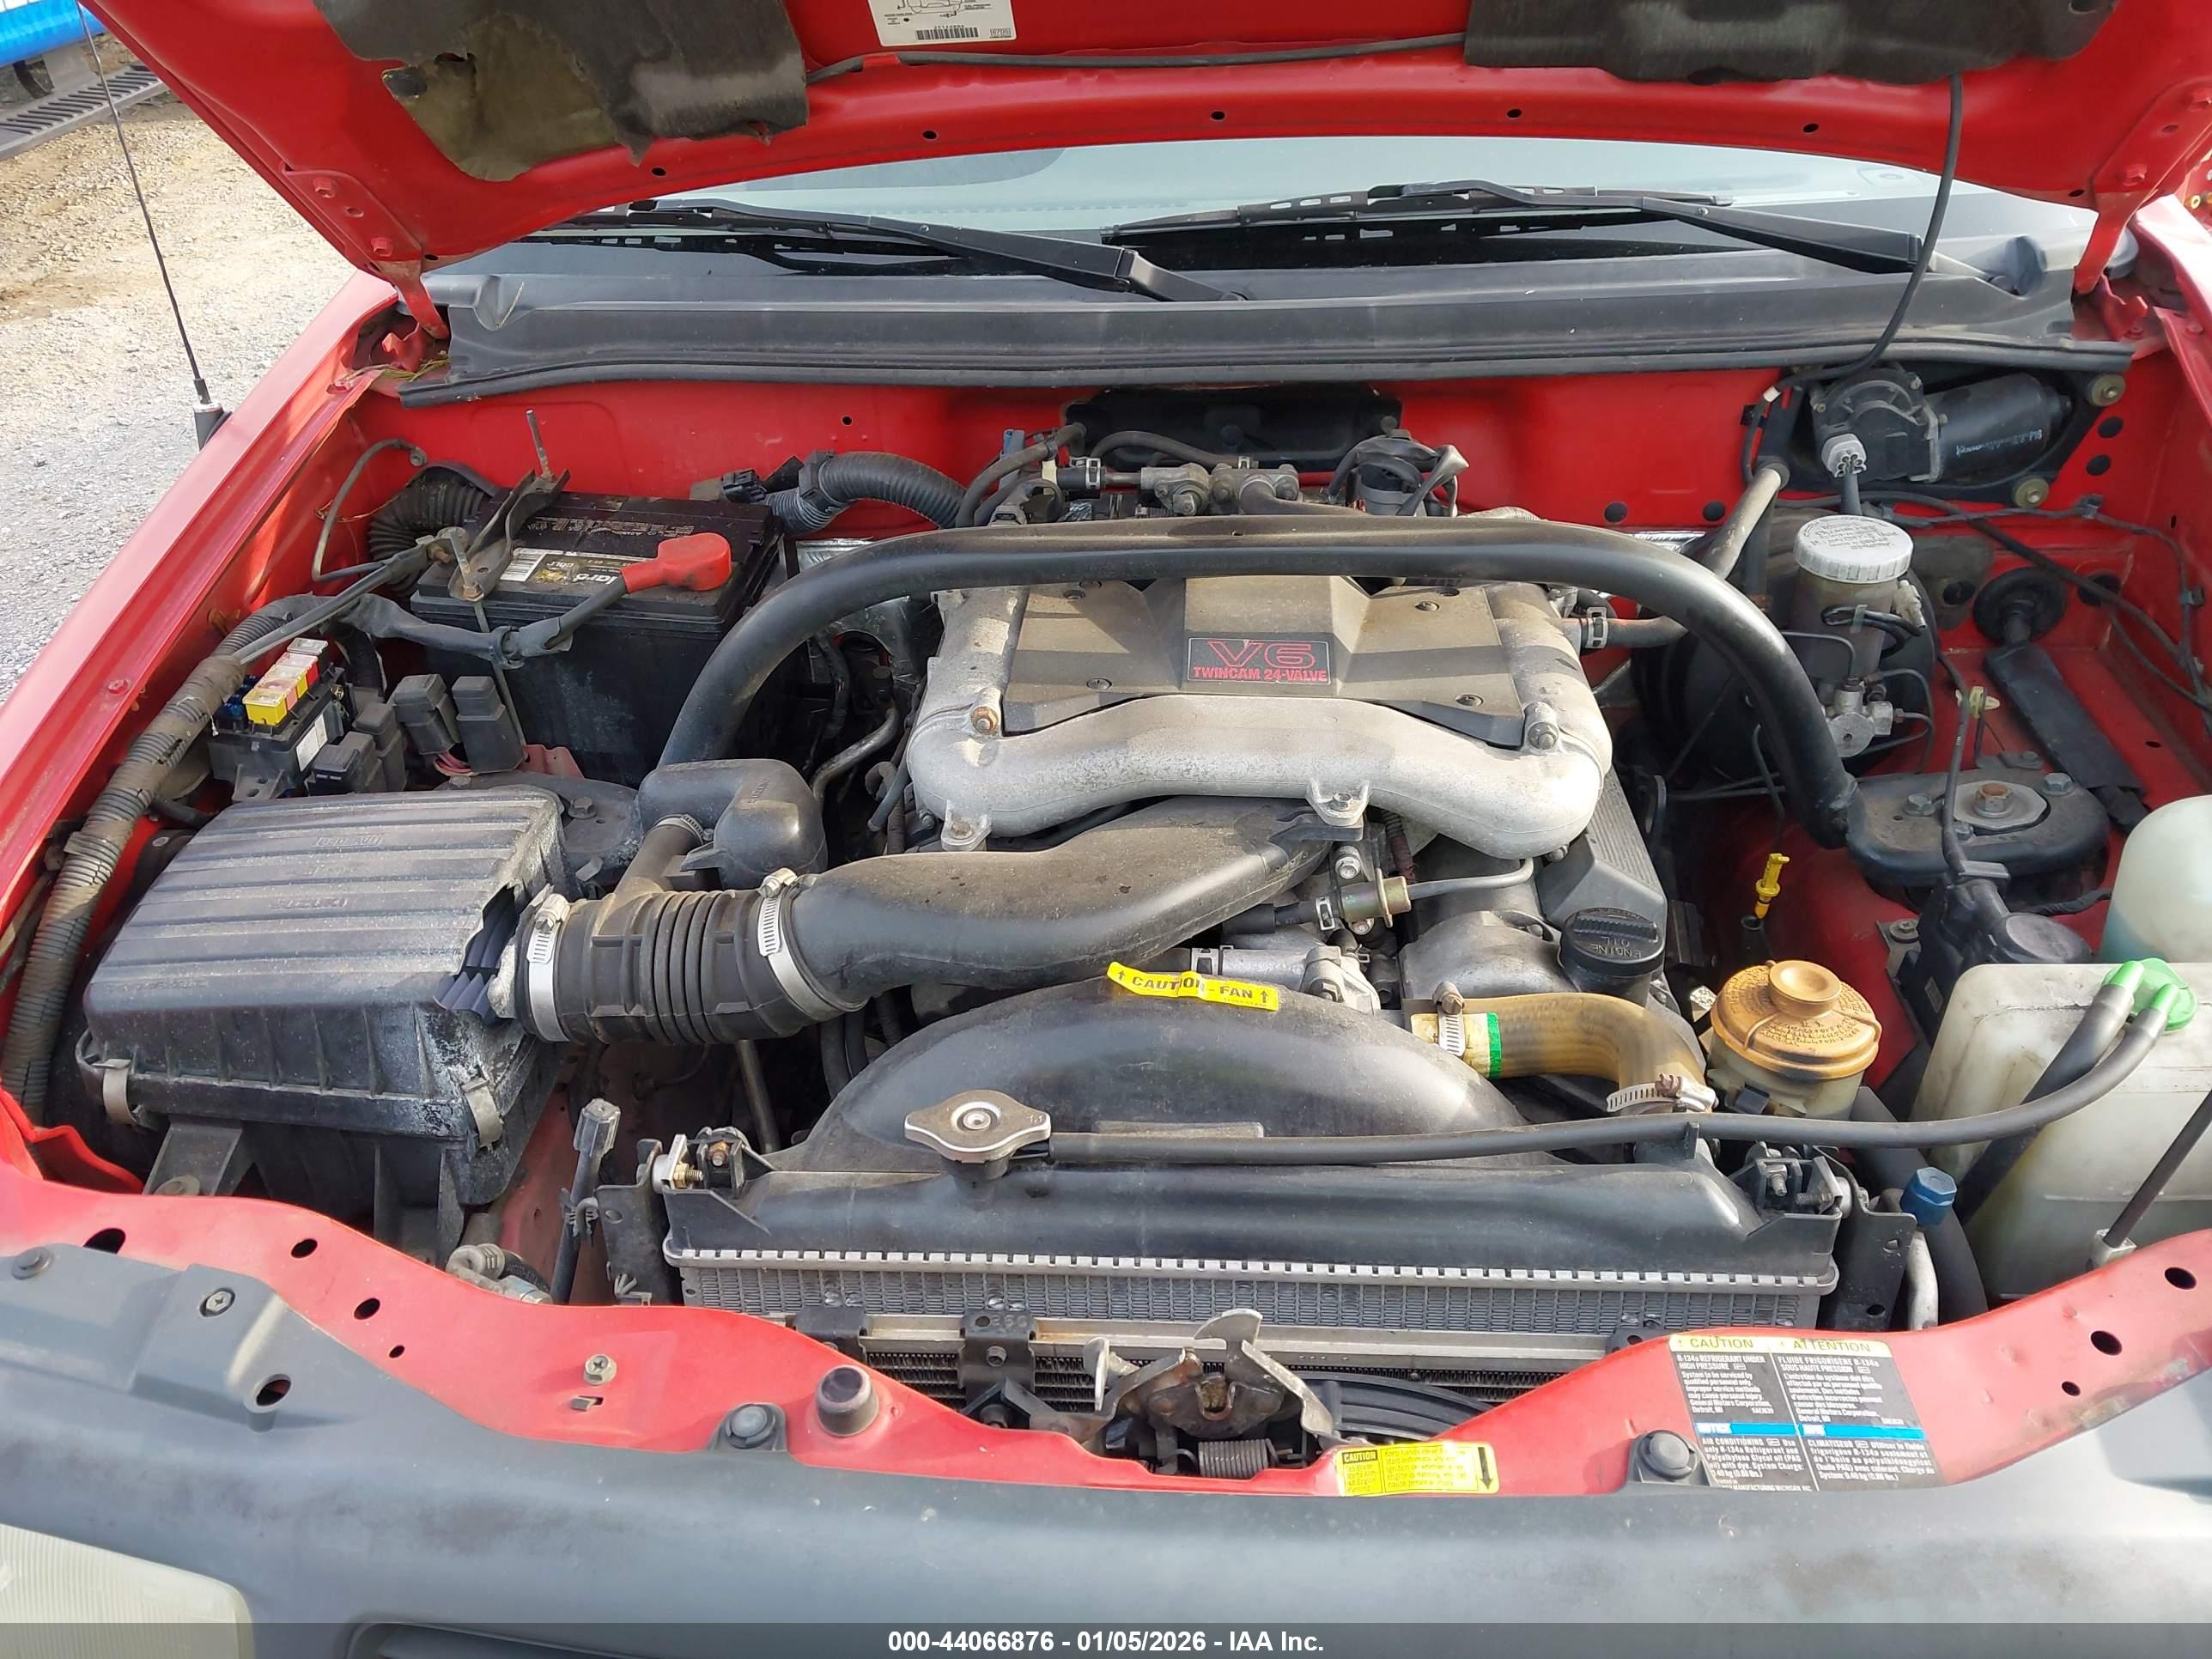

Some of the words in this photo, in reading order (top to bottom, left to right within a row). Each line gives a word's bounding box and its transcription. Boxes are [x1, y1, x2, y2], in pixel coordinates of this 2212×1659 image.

[573, 574, 618, 585] lard
[1208, 641, 1316, 669] V6
[1194, 666, 1261, 680] TWINCAM
[1264, 668, 1327, 682] 24-VALVE
[1601, 937, 1630, 947] OIL
[1589, 944, 1641, 959] ENGINE
[1219, 987, 1253, 999] FAN
[1690, 1338, 1753, 1348] CAUTION
[1794, 1340, 1870, 1352] ATTENTION
[1343, 1452, 1376, 1462] CAUTION
